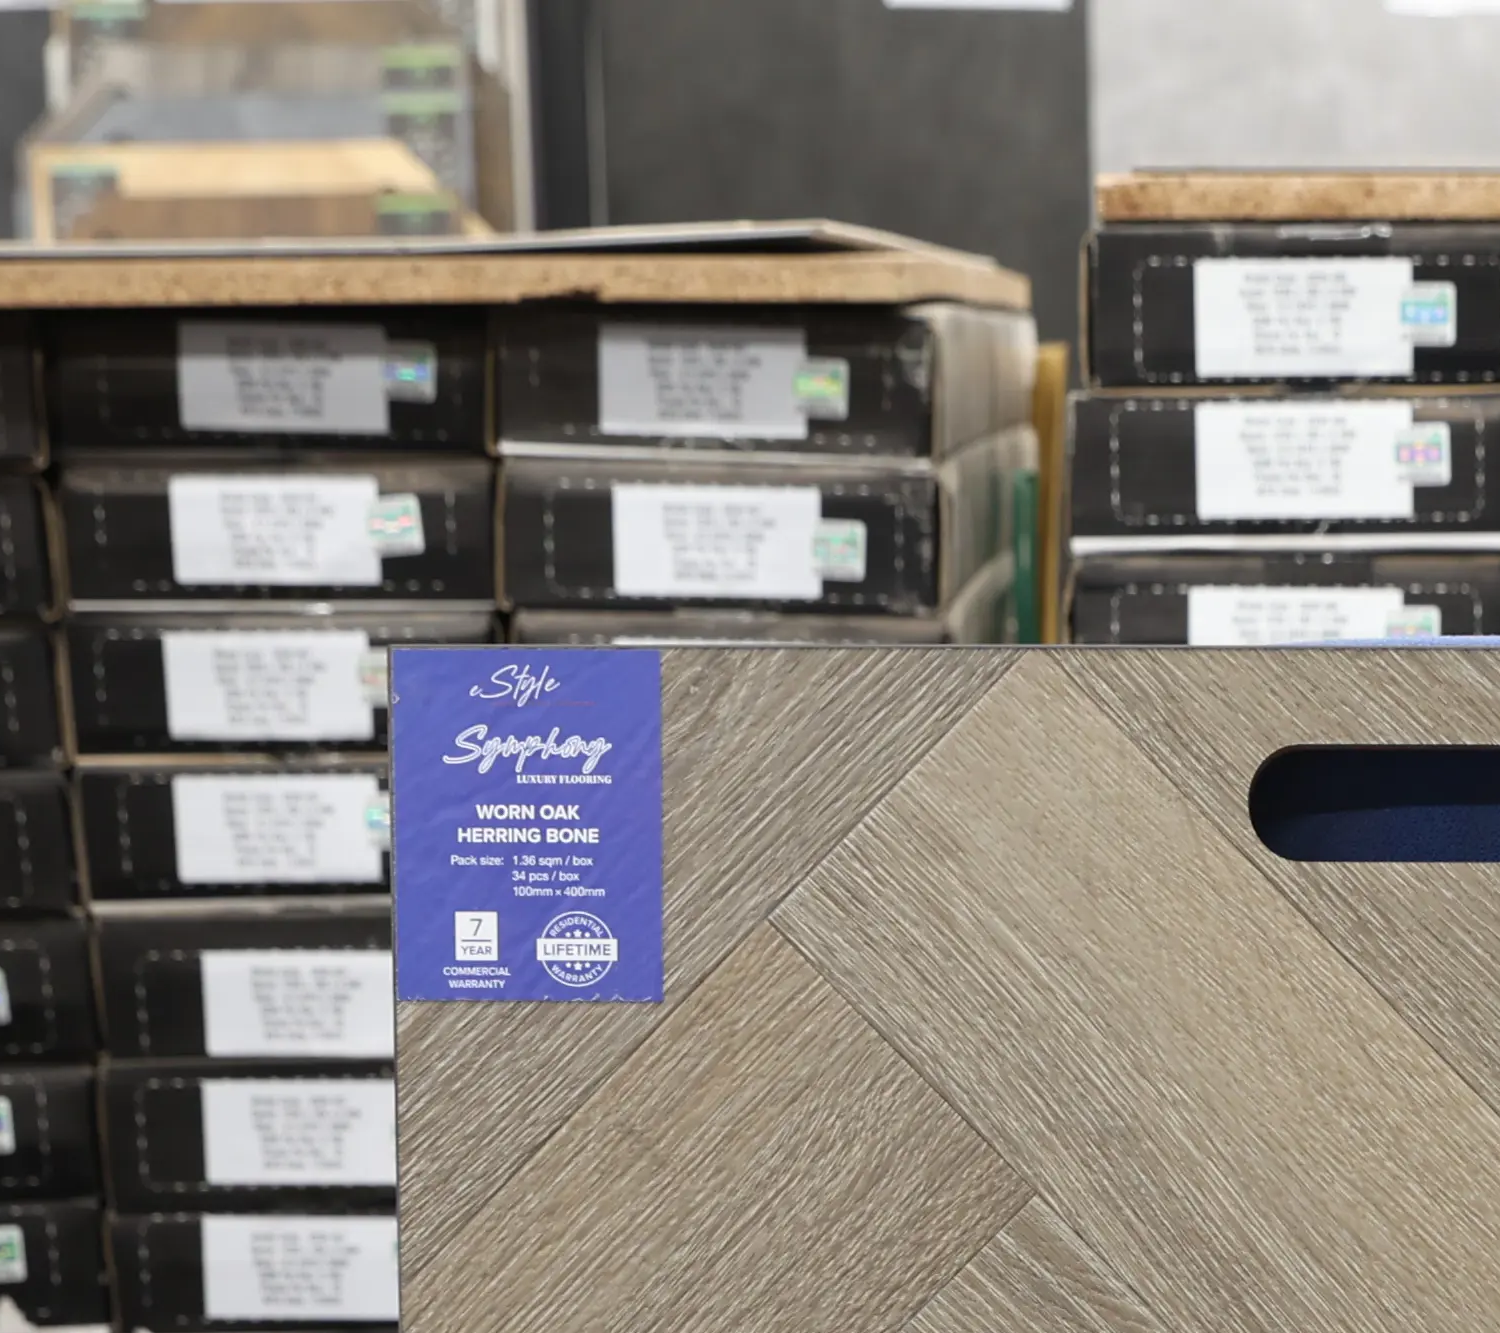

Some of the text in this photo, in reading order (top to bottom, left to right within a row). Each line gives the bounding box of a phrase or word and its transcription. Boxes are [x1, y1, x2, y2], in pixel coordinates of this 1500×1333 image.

[442, 724, 613, 774] Symphony
[516, 775, 612, 784] LUXURY FLOORING
[475, 804, 580, 820] WORN OAK
[457, 828, 600, 843] HERRING BONE
[450, 855, 478, 866] Pack
[479, 855, 504, 866] size:
[512, 855, 536, 866] 1.36
[538, 857, 563, 868] sqm
[572, 855, 593, 866] box
[512, 871, 526, 882] 34
[529, 872, 550, 883] pcs
[559, 871, 580, 882] box
[513, 886, 554, 897] 100mm
[563, 886, 605, 897] 400mm
[469, 918, 483, 937] 7
[549, 916, 604, 938] RESIDENTIAL
[461, 946, 493, 956] YEAR
[543, 943, 612, 956] LIFETIME
[443, 967, 511, 977] COMMERCIAL
[551, 964, 603, 982] WARRANTY
[448, 979, 506, 989] WARRANTY
